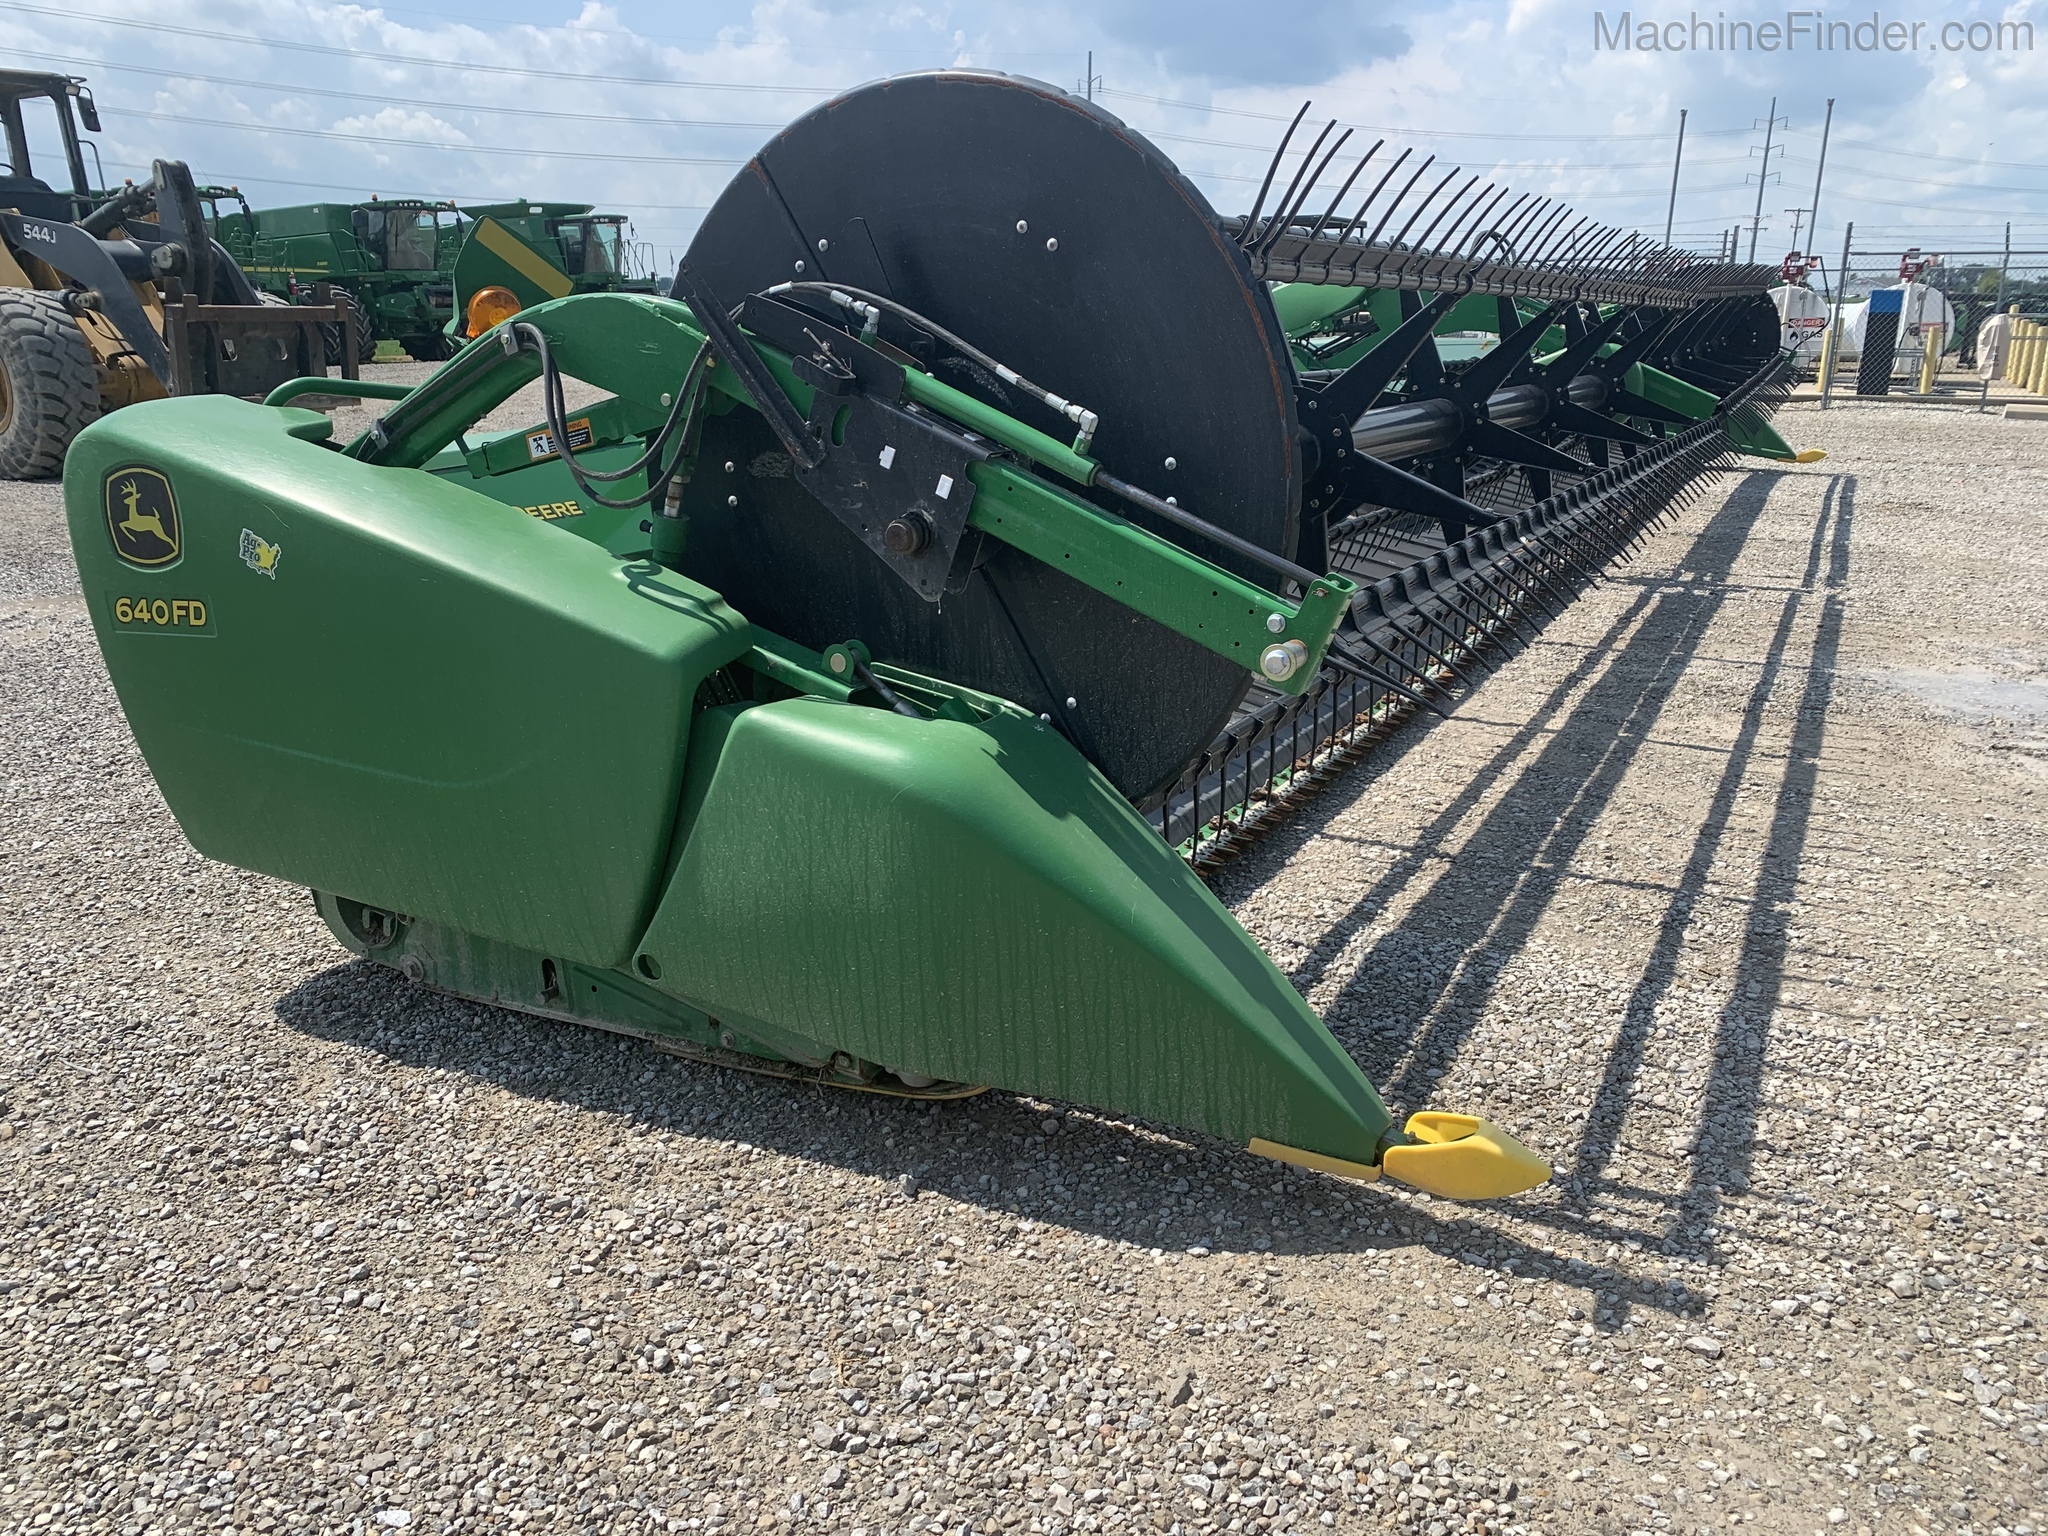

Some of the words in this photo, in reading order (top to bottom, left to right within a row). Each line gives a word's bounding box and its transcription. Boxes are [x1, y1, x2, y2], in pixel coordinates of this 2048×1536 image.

[23, 223, 56, 244] 544J
[1801, 330, 1823, 339] GAS
[512, 500, 585, 520] EERE
[242, 545, 260, 561] Pro
[115, 597, 207, 626] 640FD
